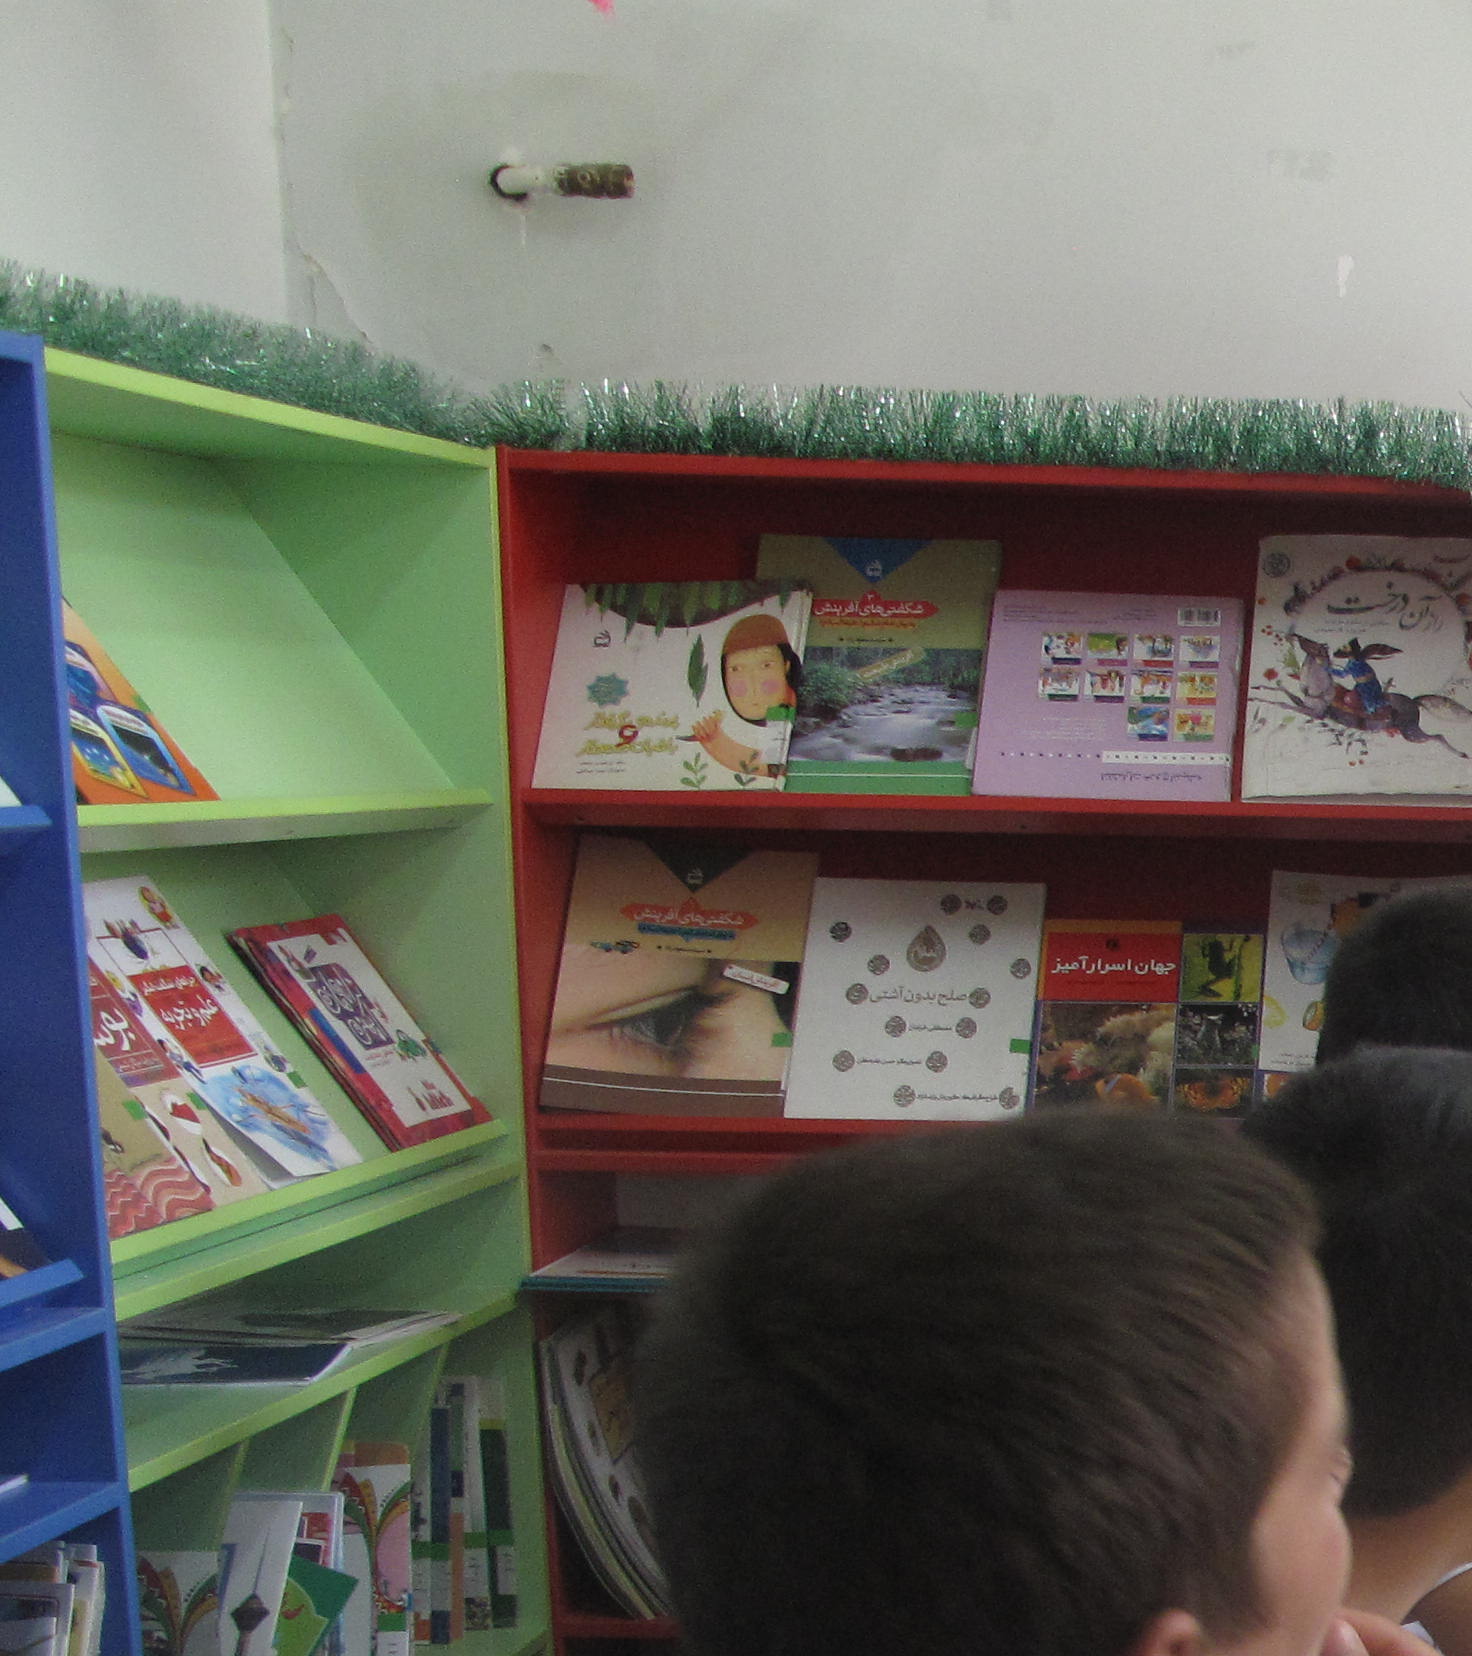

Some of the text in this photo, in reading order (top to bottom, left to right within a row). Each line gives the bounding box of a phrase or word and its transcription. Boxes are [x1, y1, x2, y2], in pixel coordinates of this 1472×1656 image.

[814, 599, 859, 617] آفرینش
[1327, 581, 1409, 614] درخت
[1399, 595, 1442, 631] آن
[1135, 959, 1177, 975] جهان
[195, 994, 219, 1024] علم
[869, 987, 967, 1006] صلح بدون آشتی
[160, 1000, 194, 1031] تجربه
